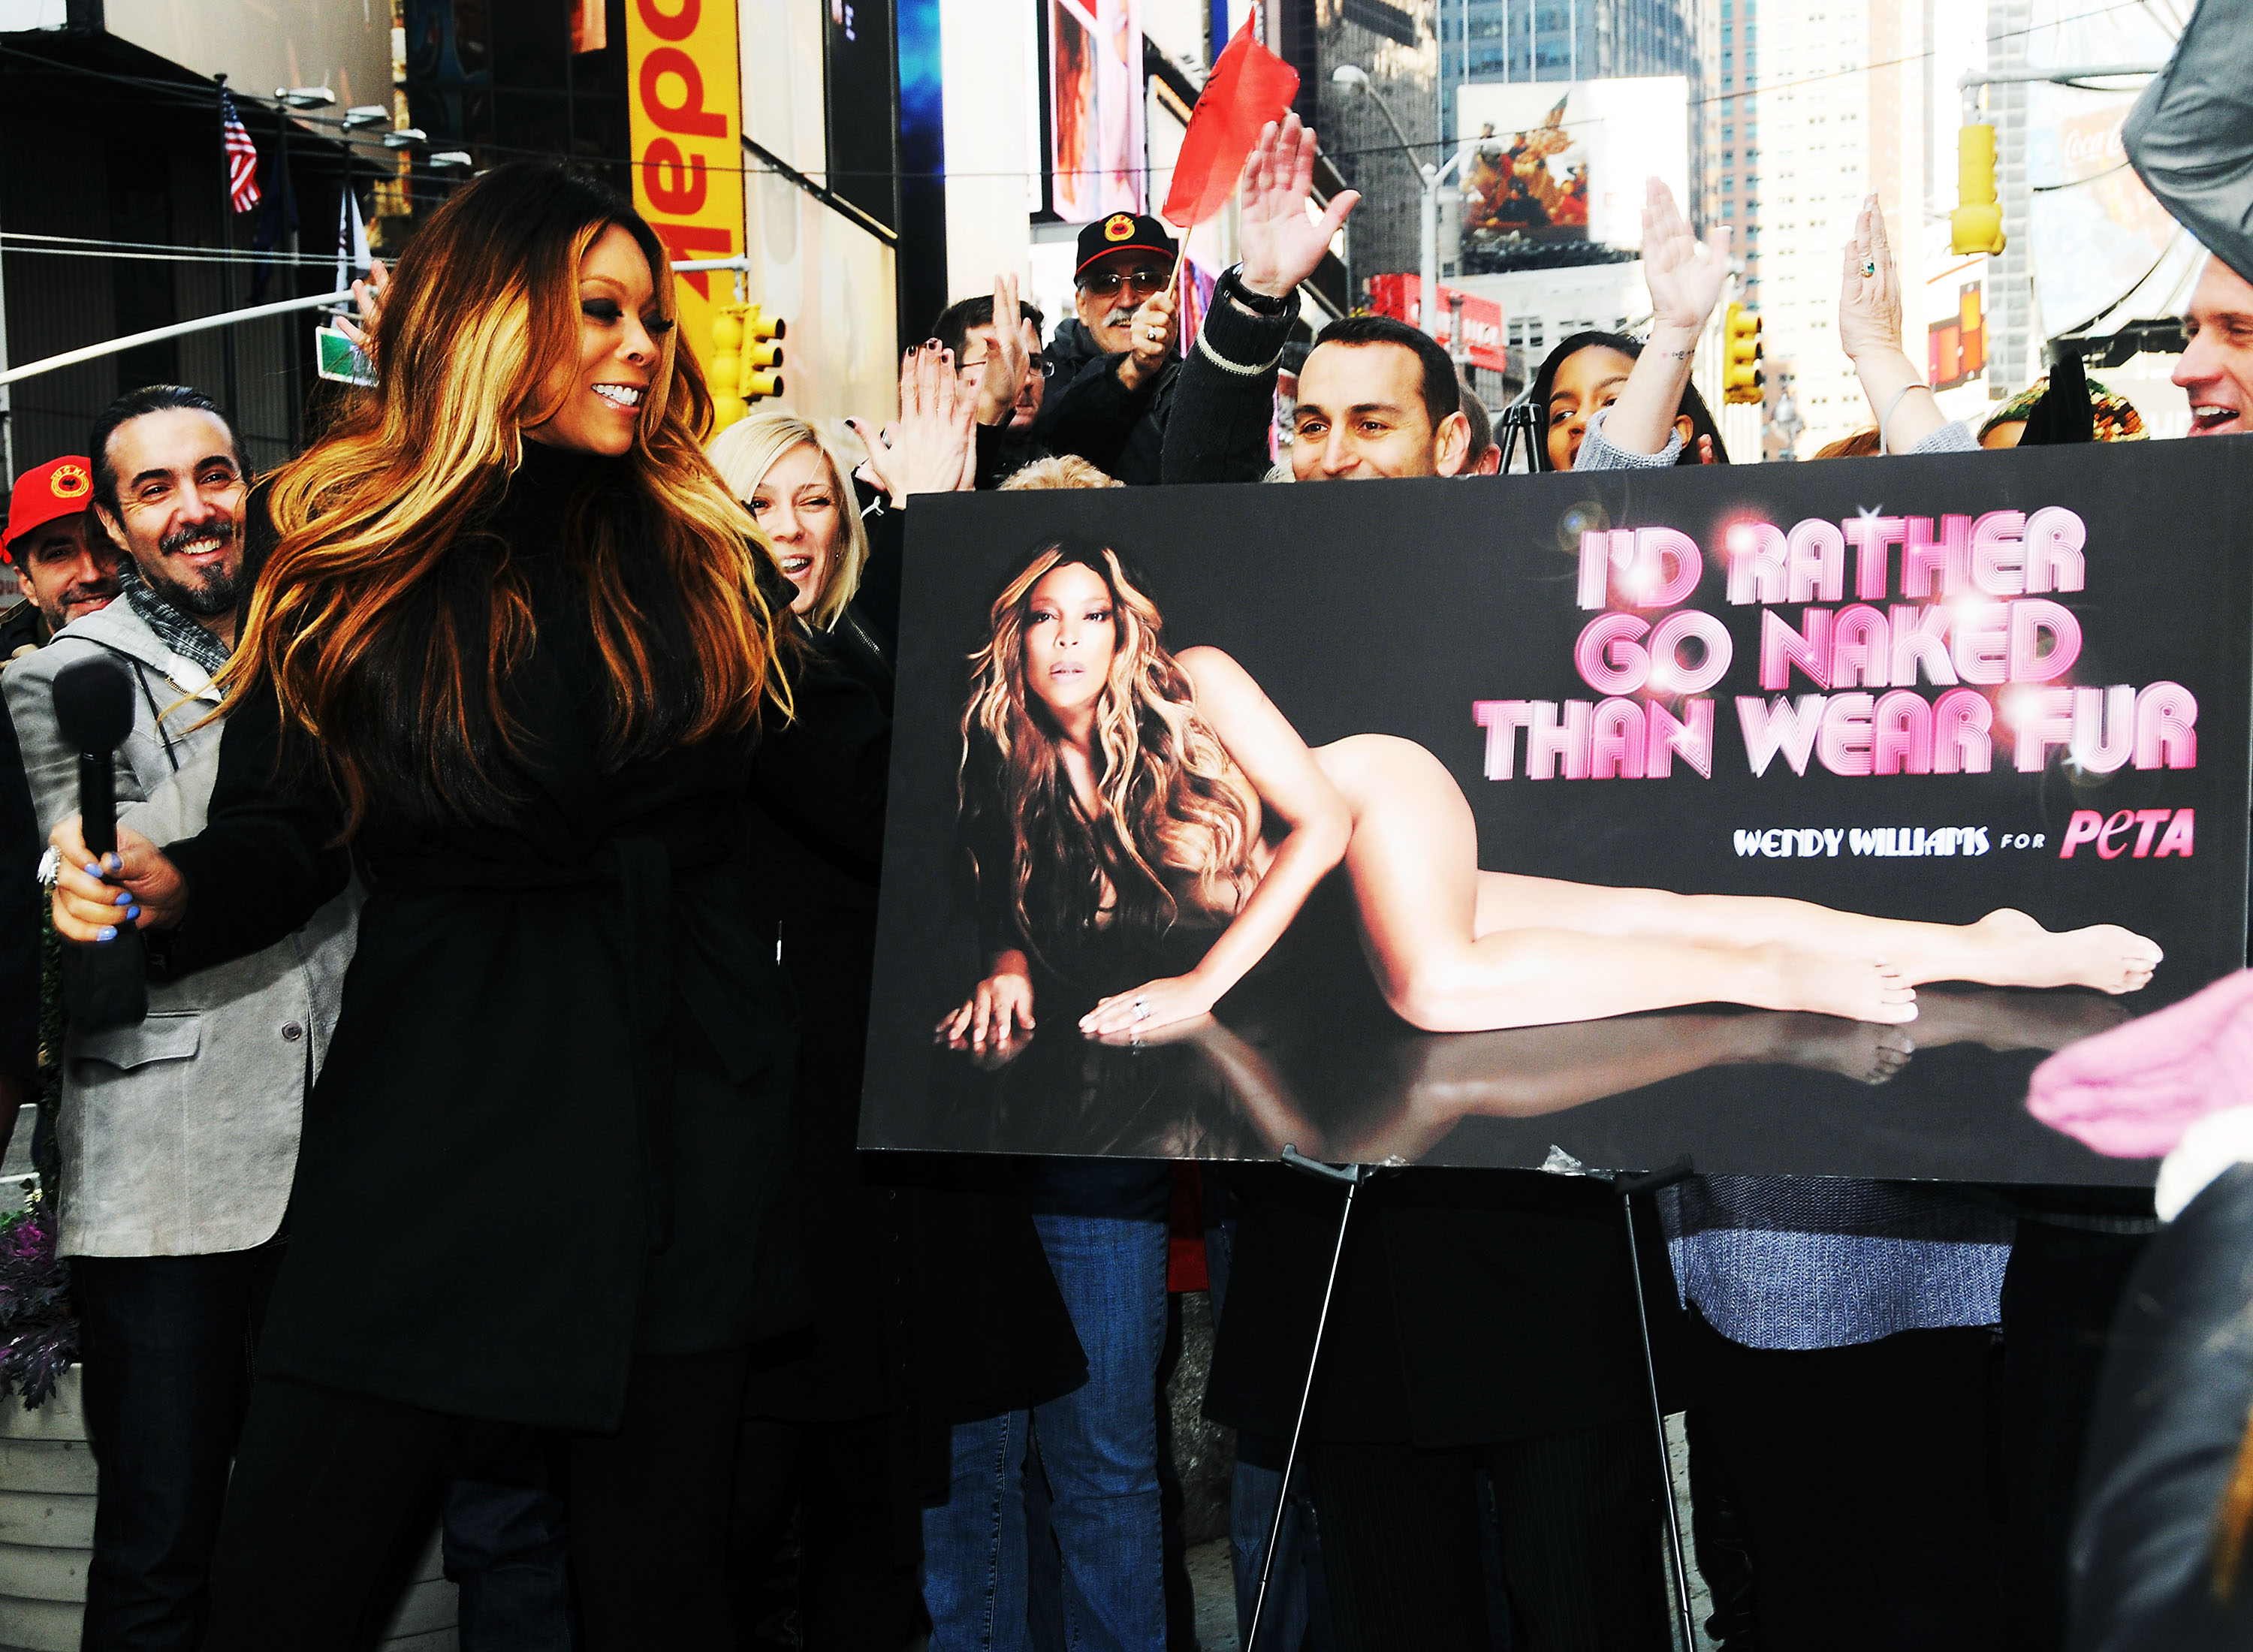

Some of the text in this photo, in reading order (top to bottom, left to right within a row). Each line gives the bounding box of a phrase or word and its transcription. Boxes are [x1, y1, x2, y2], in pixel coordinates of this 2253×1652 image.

[2064, 128, 2106, 166] Coca
[1577, 505, 2087, 610] I'D RATHER
[1574, 598, 2083, 696] GO NAKED
[1472, 680, 2198, 781] THAN WEAR FUR
[1733, 828, 1844, 858] WENDY
[1848, 826, 1990, 857] WILLIAMS
[2000, 833, 2046, 849] FOR
